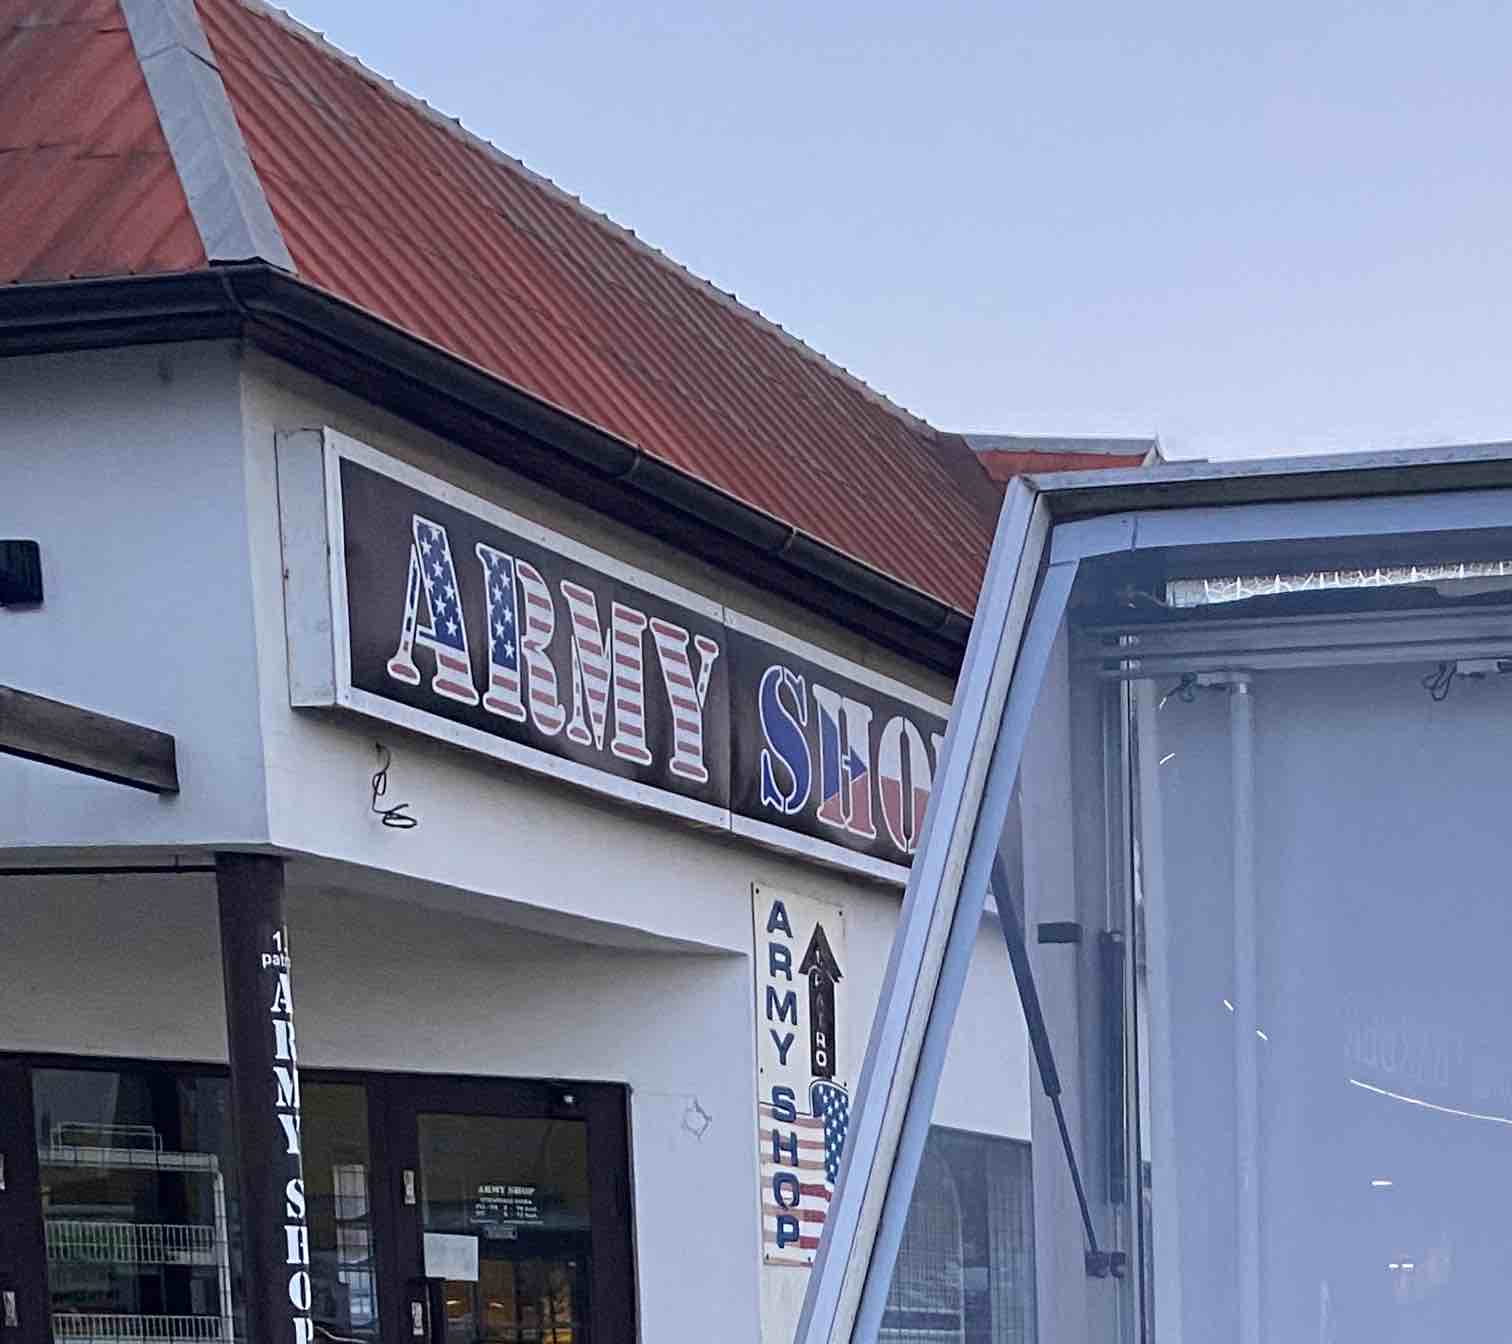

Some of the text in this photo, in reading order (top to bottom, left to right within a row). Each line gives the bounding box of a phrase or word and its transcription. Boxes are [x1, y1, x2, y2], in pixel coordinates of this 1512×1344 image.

[387, 514, 946, 854] ARMY SHO
[270, 973, 301, 1154] ARMY
[767, 900, 801, 1248] ARMY SHOP
